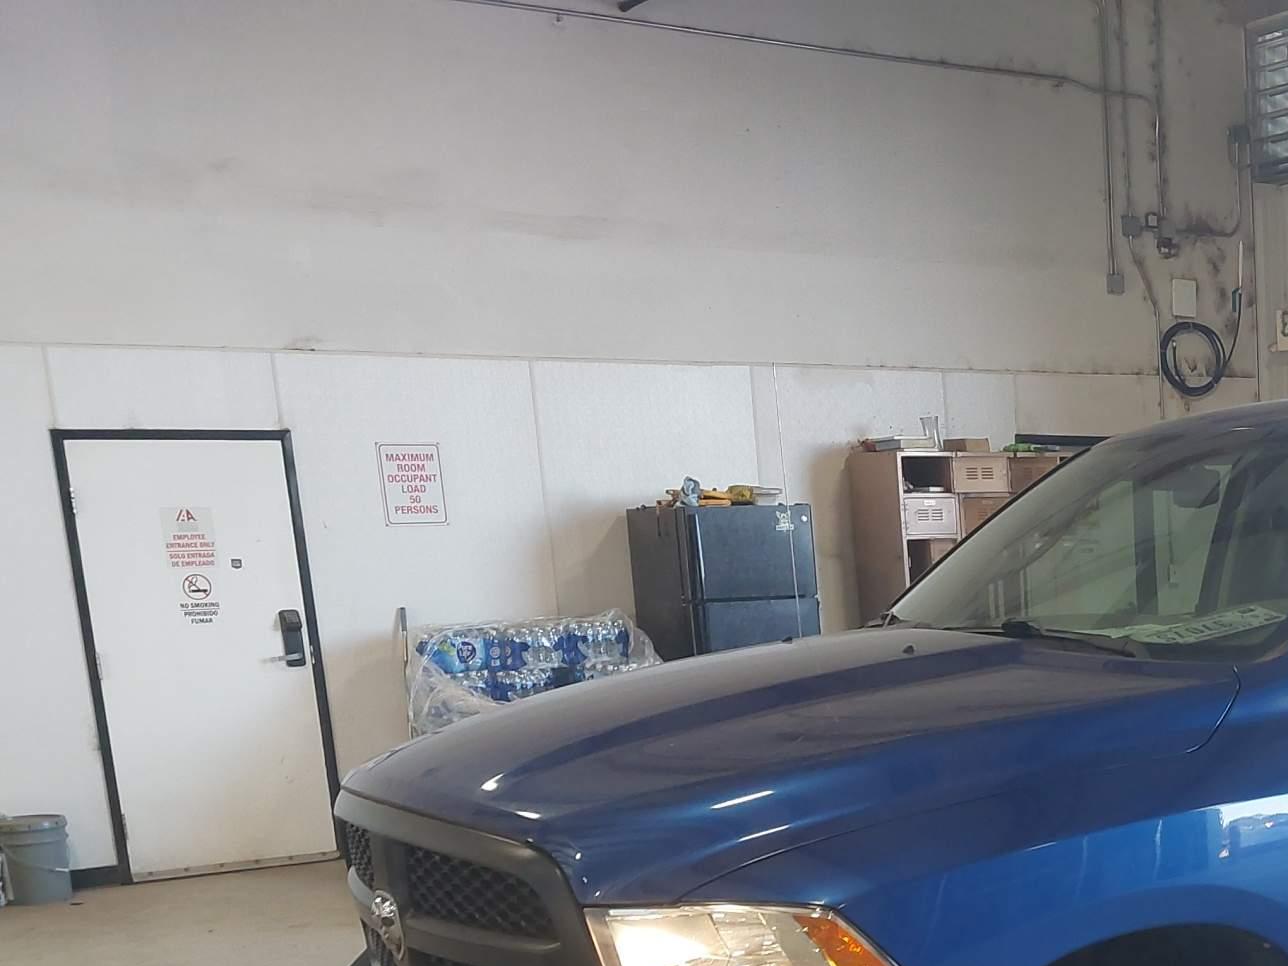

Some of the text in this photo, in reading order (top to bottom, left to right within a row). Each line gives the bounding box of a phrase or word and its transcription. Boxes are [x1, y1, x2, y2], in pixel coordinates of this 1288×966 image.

[385, 453, 434, 462] MAXIMUM
[397, 463, 426, 473] ROOM
[387, 474, 437, 483] OCCUPANT
[401, 484, 426, 494] LOAD
[409, 495, 421, 504] 50
[394, 505, 439, 514] PERSONS
[184, 609, 218, 617] PROHIBIDO
